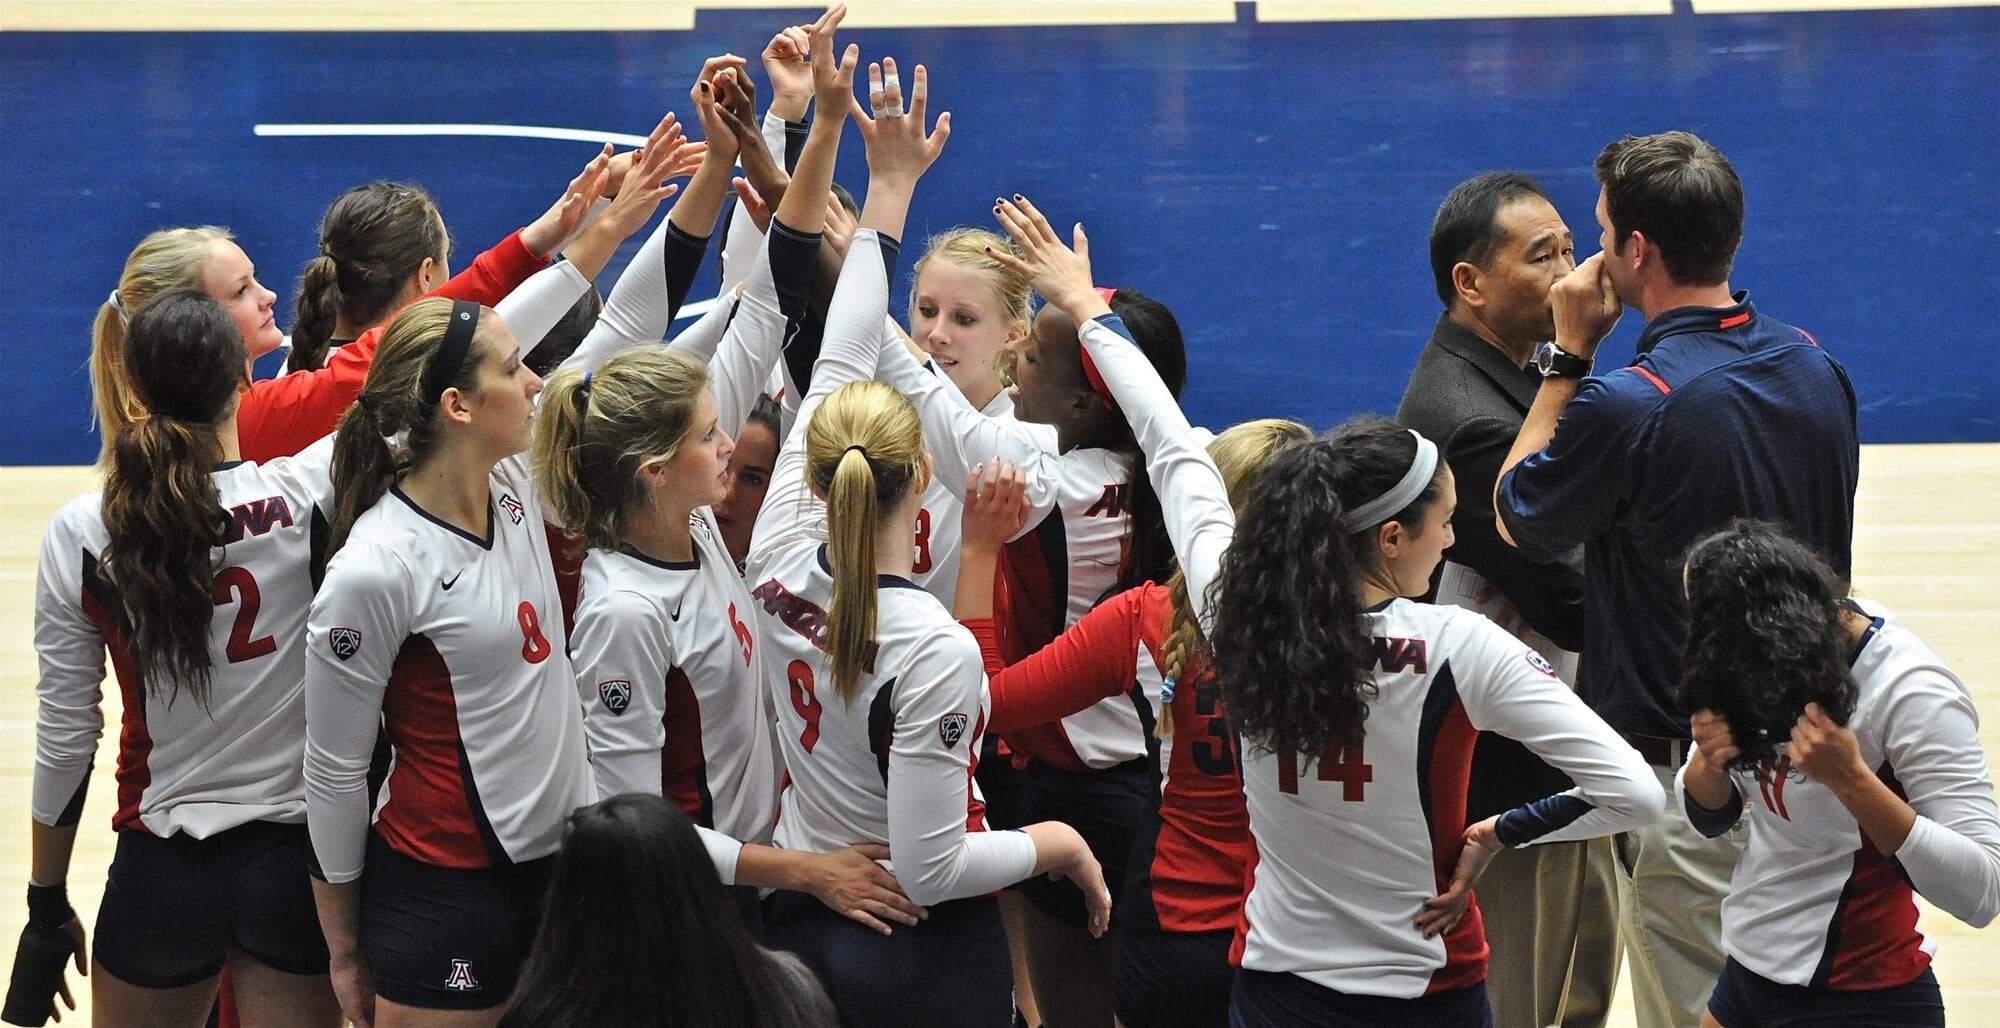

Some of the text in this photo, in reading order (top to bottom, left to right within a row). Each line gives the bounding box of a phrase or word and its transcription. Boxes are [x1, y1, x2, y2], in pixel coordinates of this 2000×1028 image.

[213, 566, 278, 664] 2
[331, 629, 360, 648] PAC
[517, 601, 551, 664] 8
[728, 601, 753, 668] 5
[336, 643, 351, 656] 12
[600, 681, 630, 702] PAC
[608, 695, 624, 709] 12
[787, 659, 823, 755] 9
[941, 714, 967, 731] PAC
[944, 728, 958, 742] 12
[445, 958, 479, 991] A
